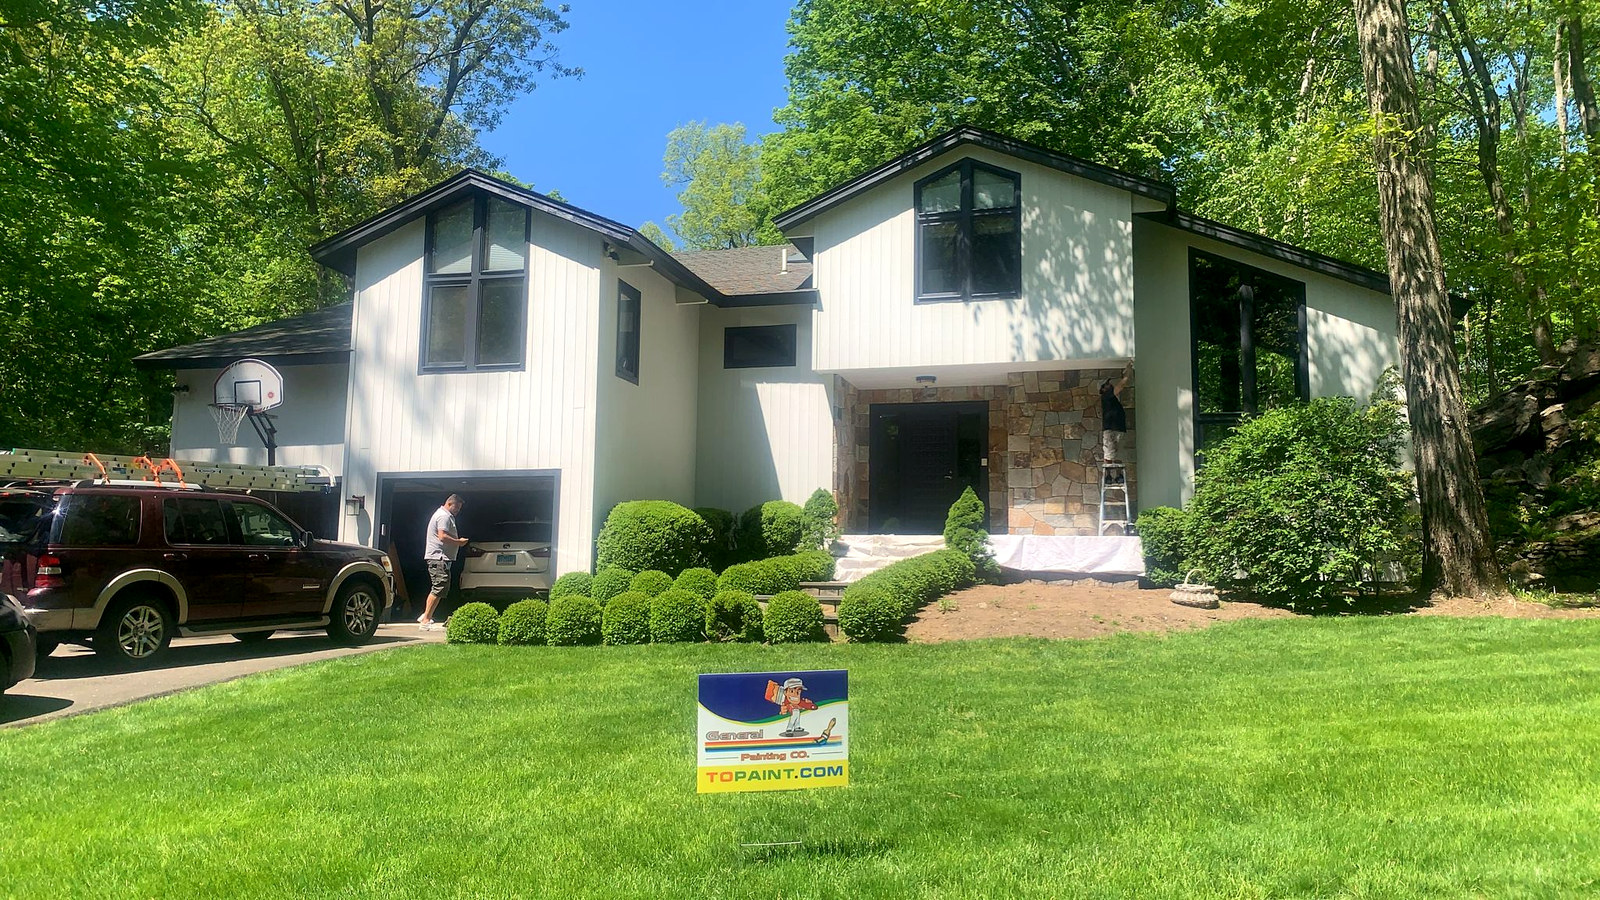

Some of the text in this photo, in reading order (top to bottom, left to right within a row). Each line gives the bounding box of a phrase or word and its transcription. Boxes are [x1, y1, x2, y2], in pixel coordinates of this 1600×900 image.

[705, 729, 764, 741] General
[740, 750, 810, 762] Painting CO.
[706, 765, 843, 783] TOPAINT.COM
